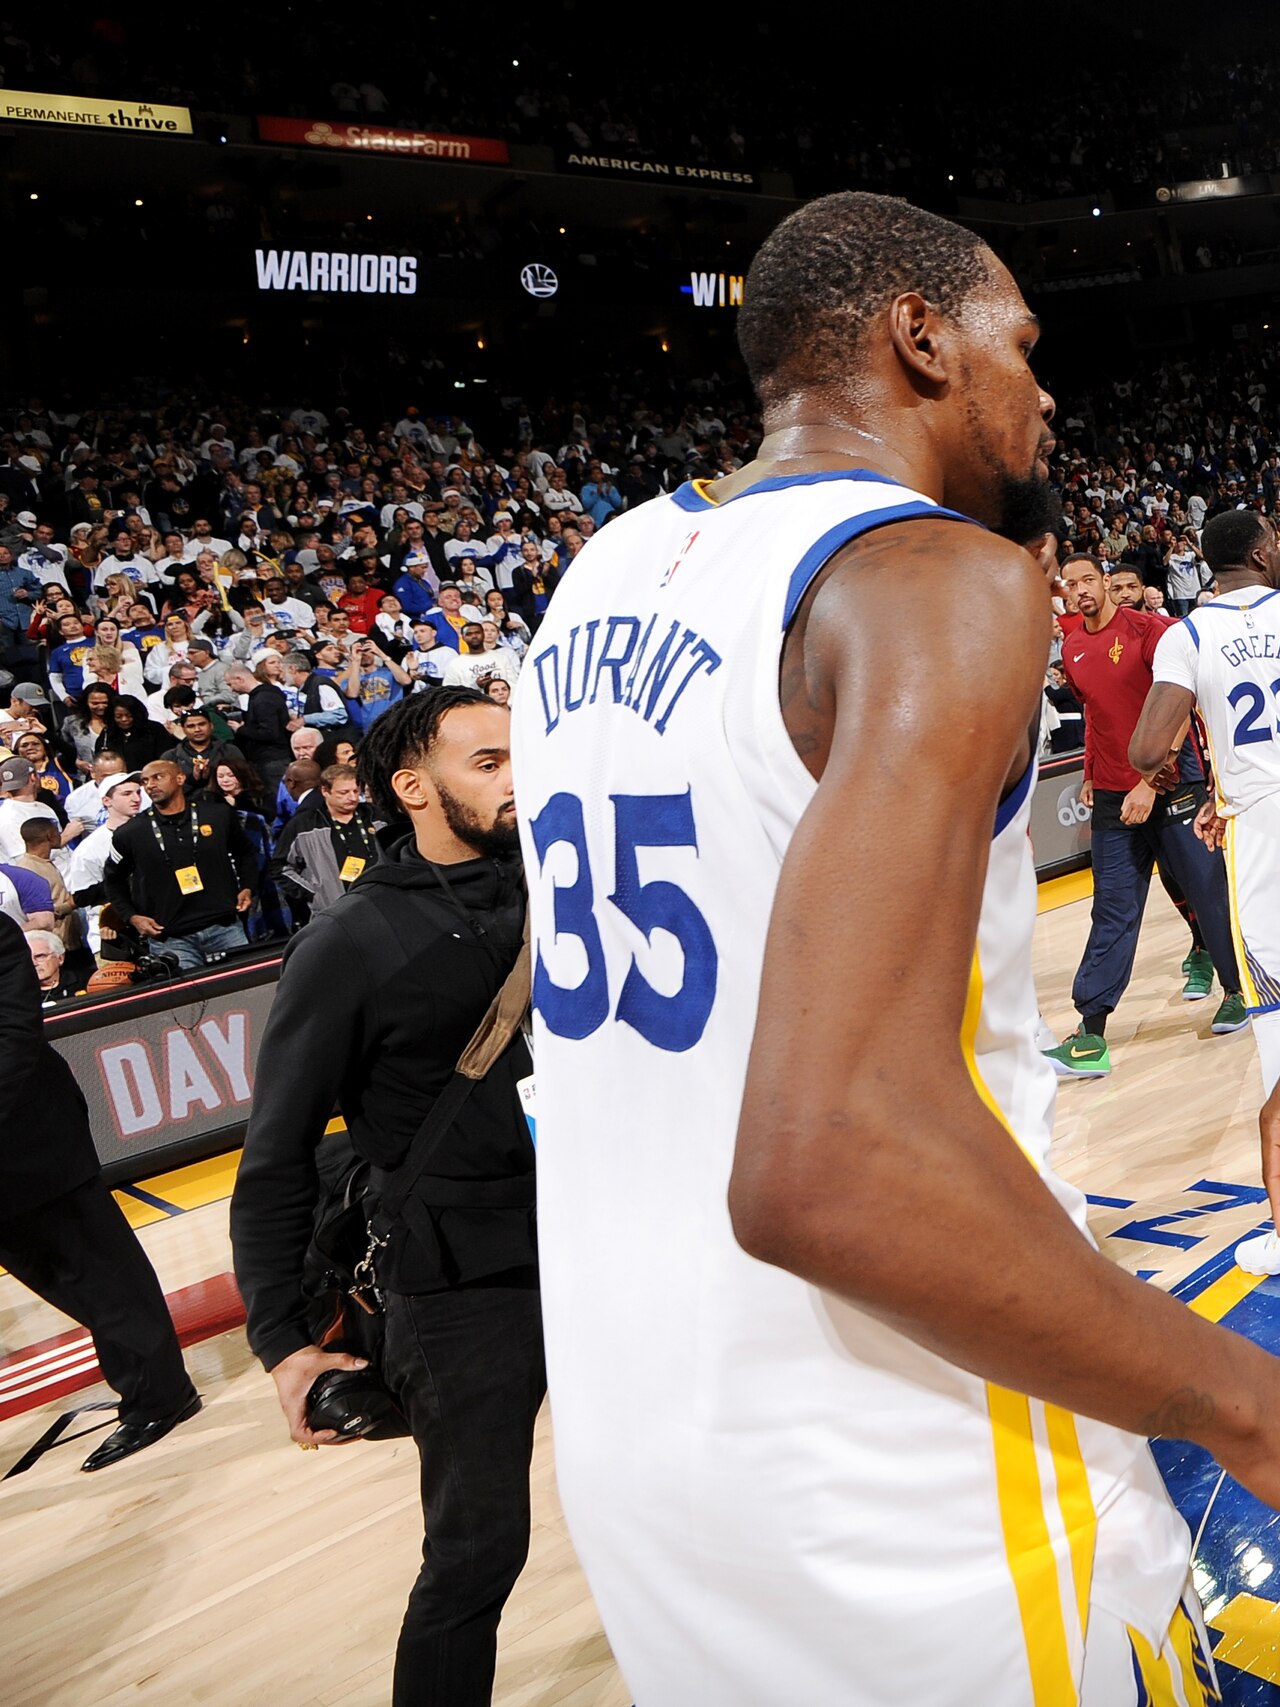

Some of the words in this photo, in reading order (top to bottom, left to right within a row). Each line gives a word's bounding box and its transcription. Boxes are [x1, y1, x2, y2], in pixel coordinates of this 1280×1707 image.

[6, 105, 101, 125] PERMANENTE
[107, 108, 178, 131] thrive
[568, 154, 670, 175] AMERICAN
[674, 165, 754, 184] EXPRESS
[255, 249, 418, 295] WARRIORS
[533, 612, 723, 738] DURANT
[1057, 797, 1093, 826] ab
[529, 781, 720, 1054] 35
[97, 1009, 253, 1139] DAY
